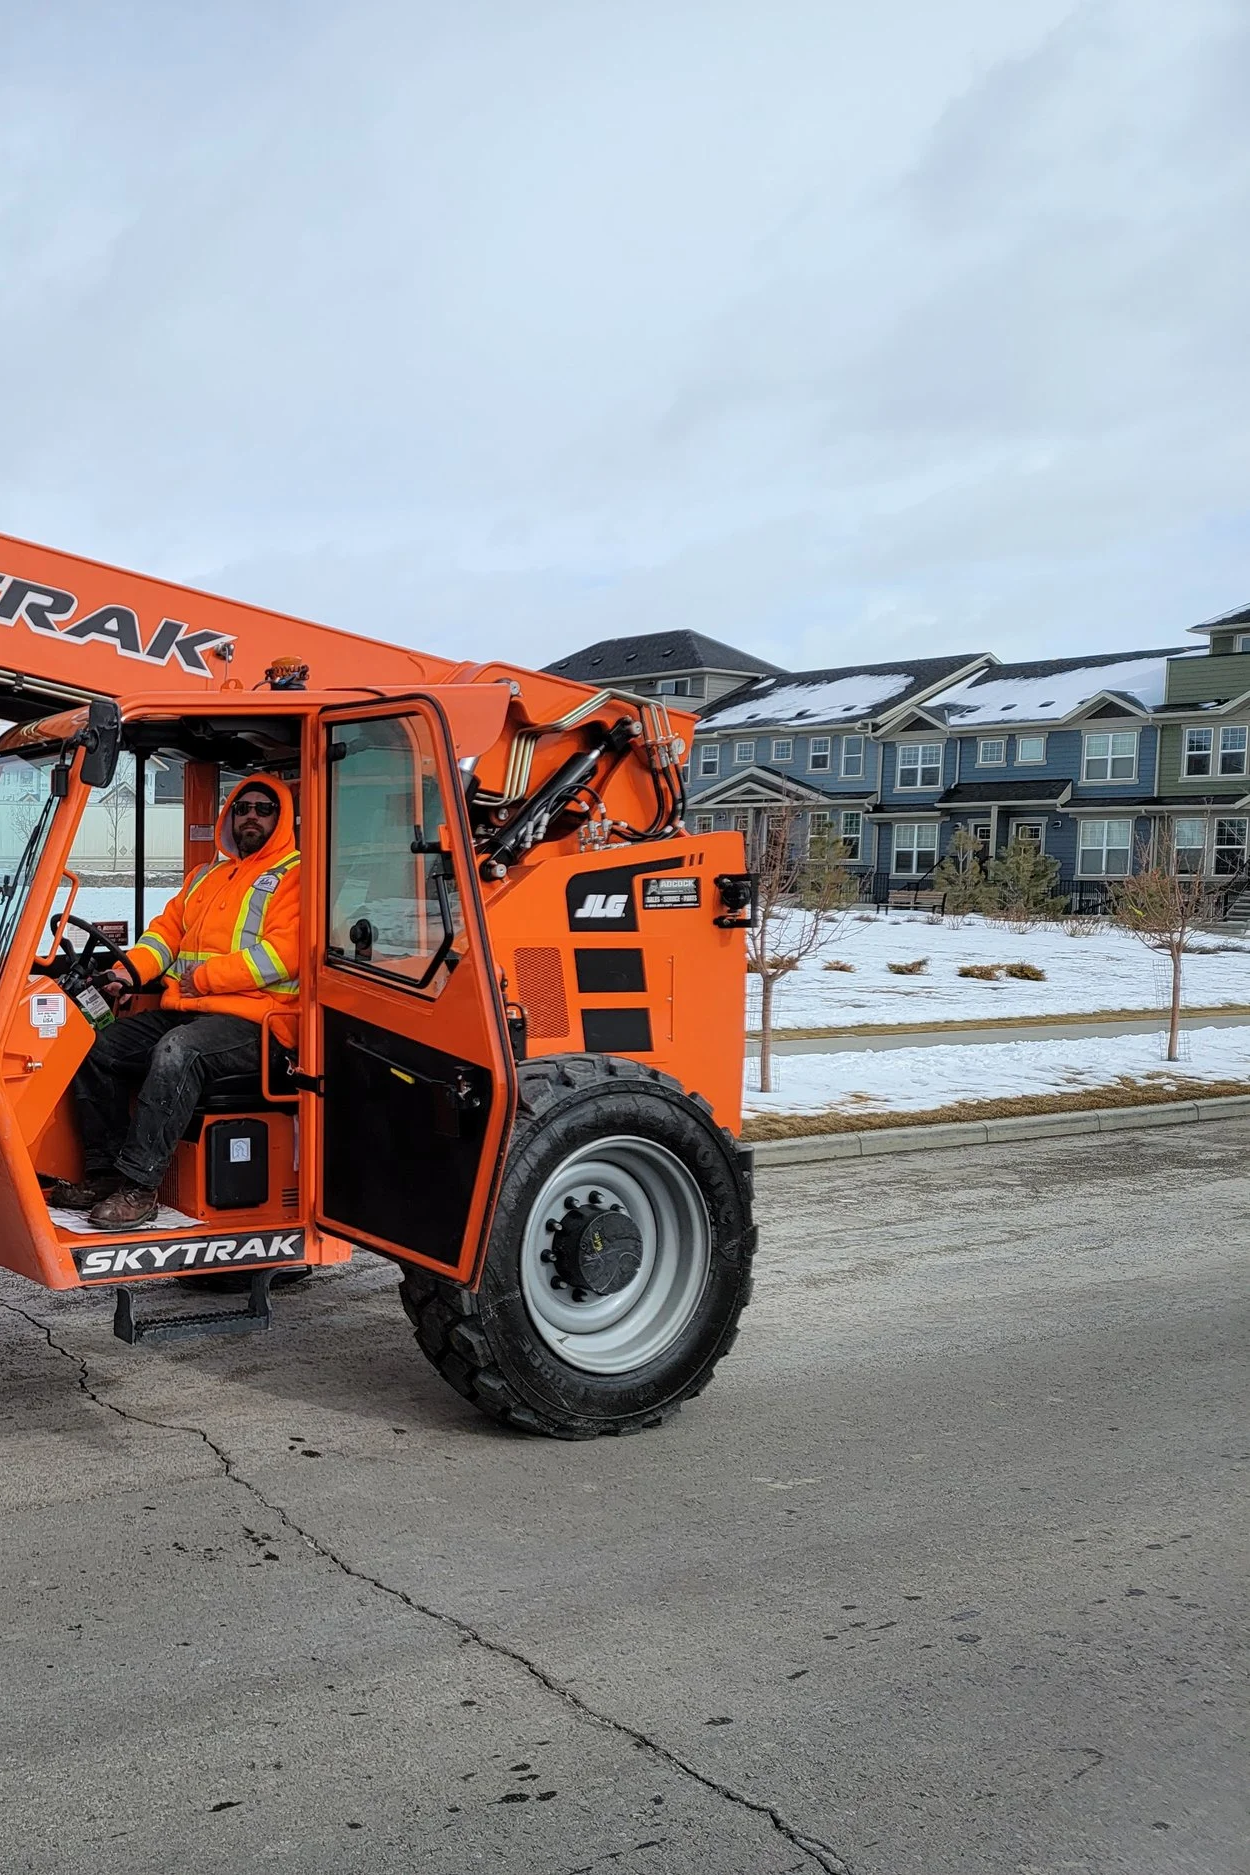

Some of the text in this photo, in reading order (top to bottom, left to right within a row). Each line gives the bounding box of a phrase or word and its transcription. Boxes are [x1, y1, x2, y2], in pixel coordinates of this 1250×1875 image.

[661, 879, 694, 888] ADCOCK
[575, 894, 628, 918] JLG
[82, 1235, 301, 1275] SKYTRAK
